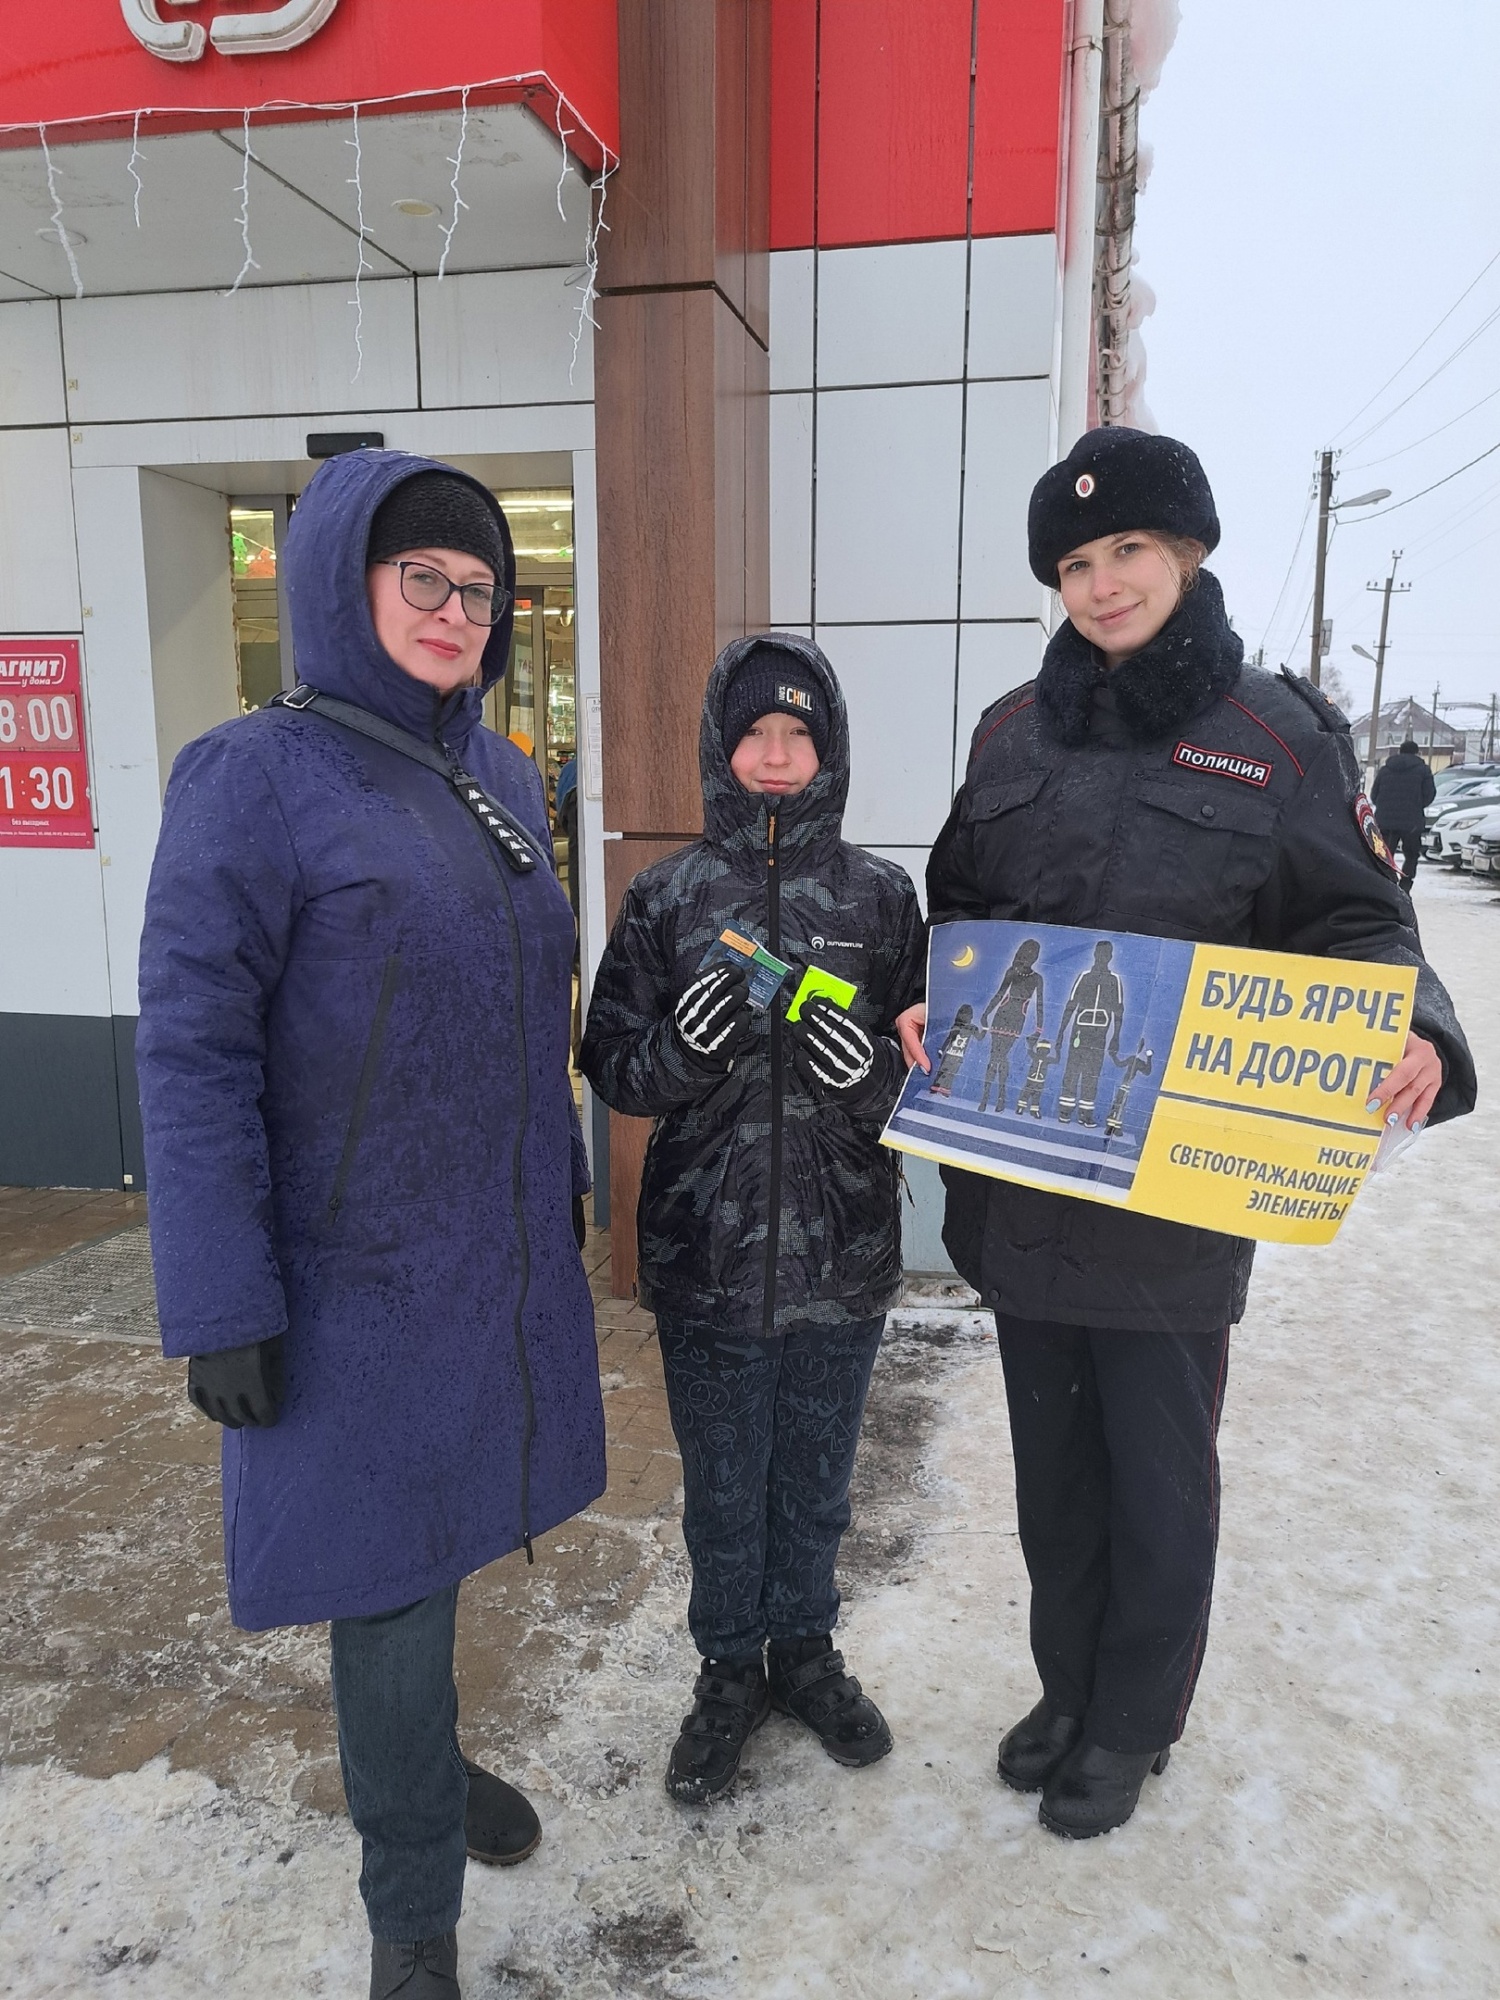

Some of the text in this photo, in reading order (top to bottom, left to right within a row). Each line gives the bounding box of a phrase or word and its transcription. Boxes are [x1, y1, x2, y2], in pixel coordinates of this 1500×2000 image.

[29, 676, 51, 685] дома
[786, 687, 812, 711] CHILL
[1179, 748, 1266, 781] ПОЛИЦИЯ
[1201, 970, 1404, 1033] БУДЬ ЯРЧЕ
[1185, 1033, 1233, 1075] НА
[1169, 1143, 1361, 1197] СВЕТООТРАЖАЮЩИЕ
[1317, 1147, 1371, 1170] НОСИ
[1245, 1189, 1348, 1221] ЭЛЕМЕНТЫ
